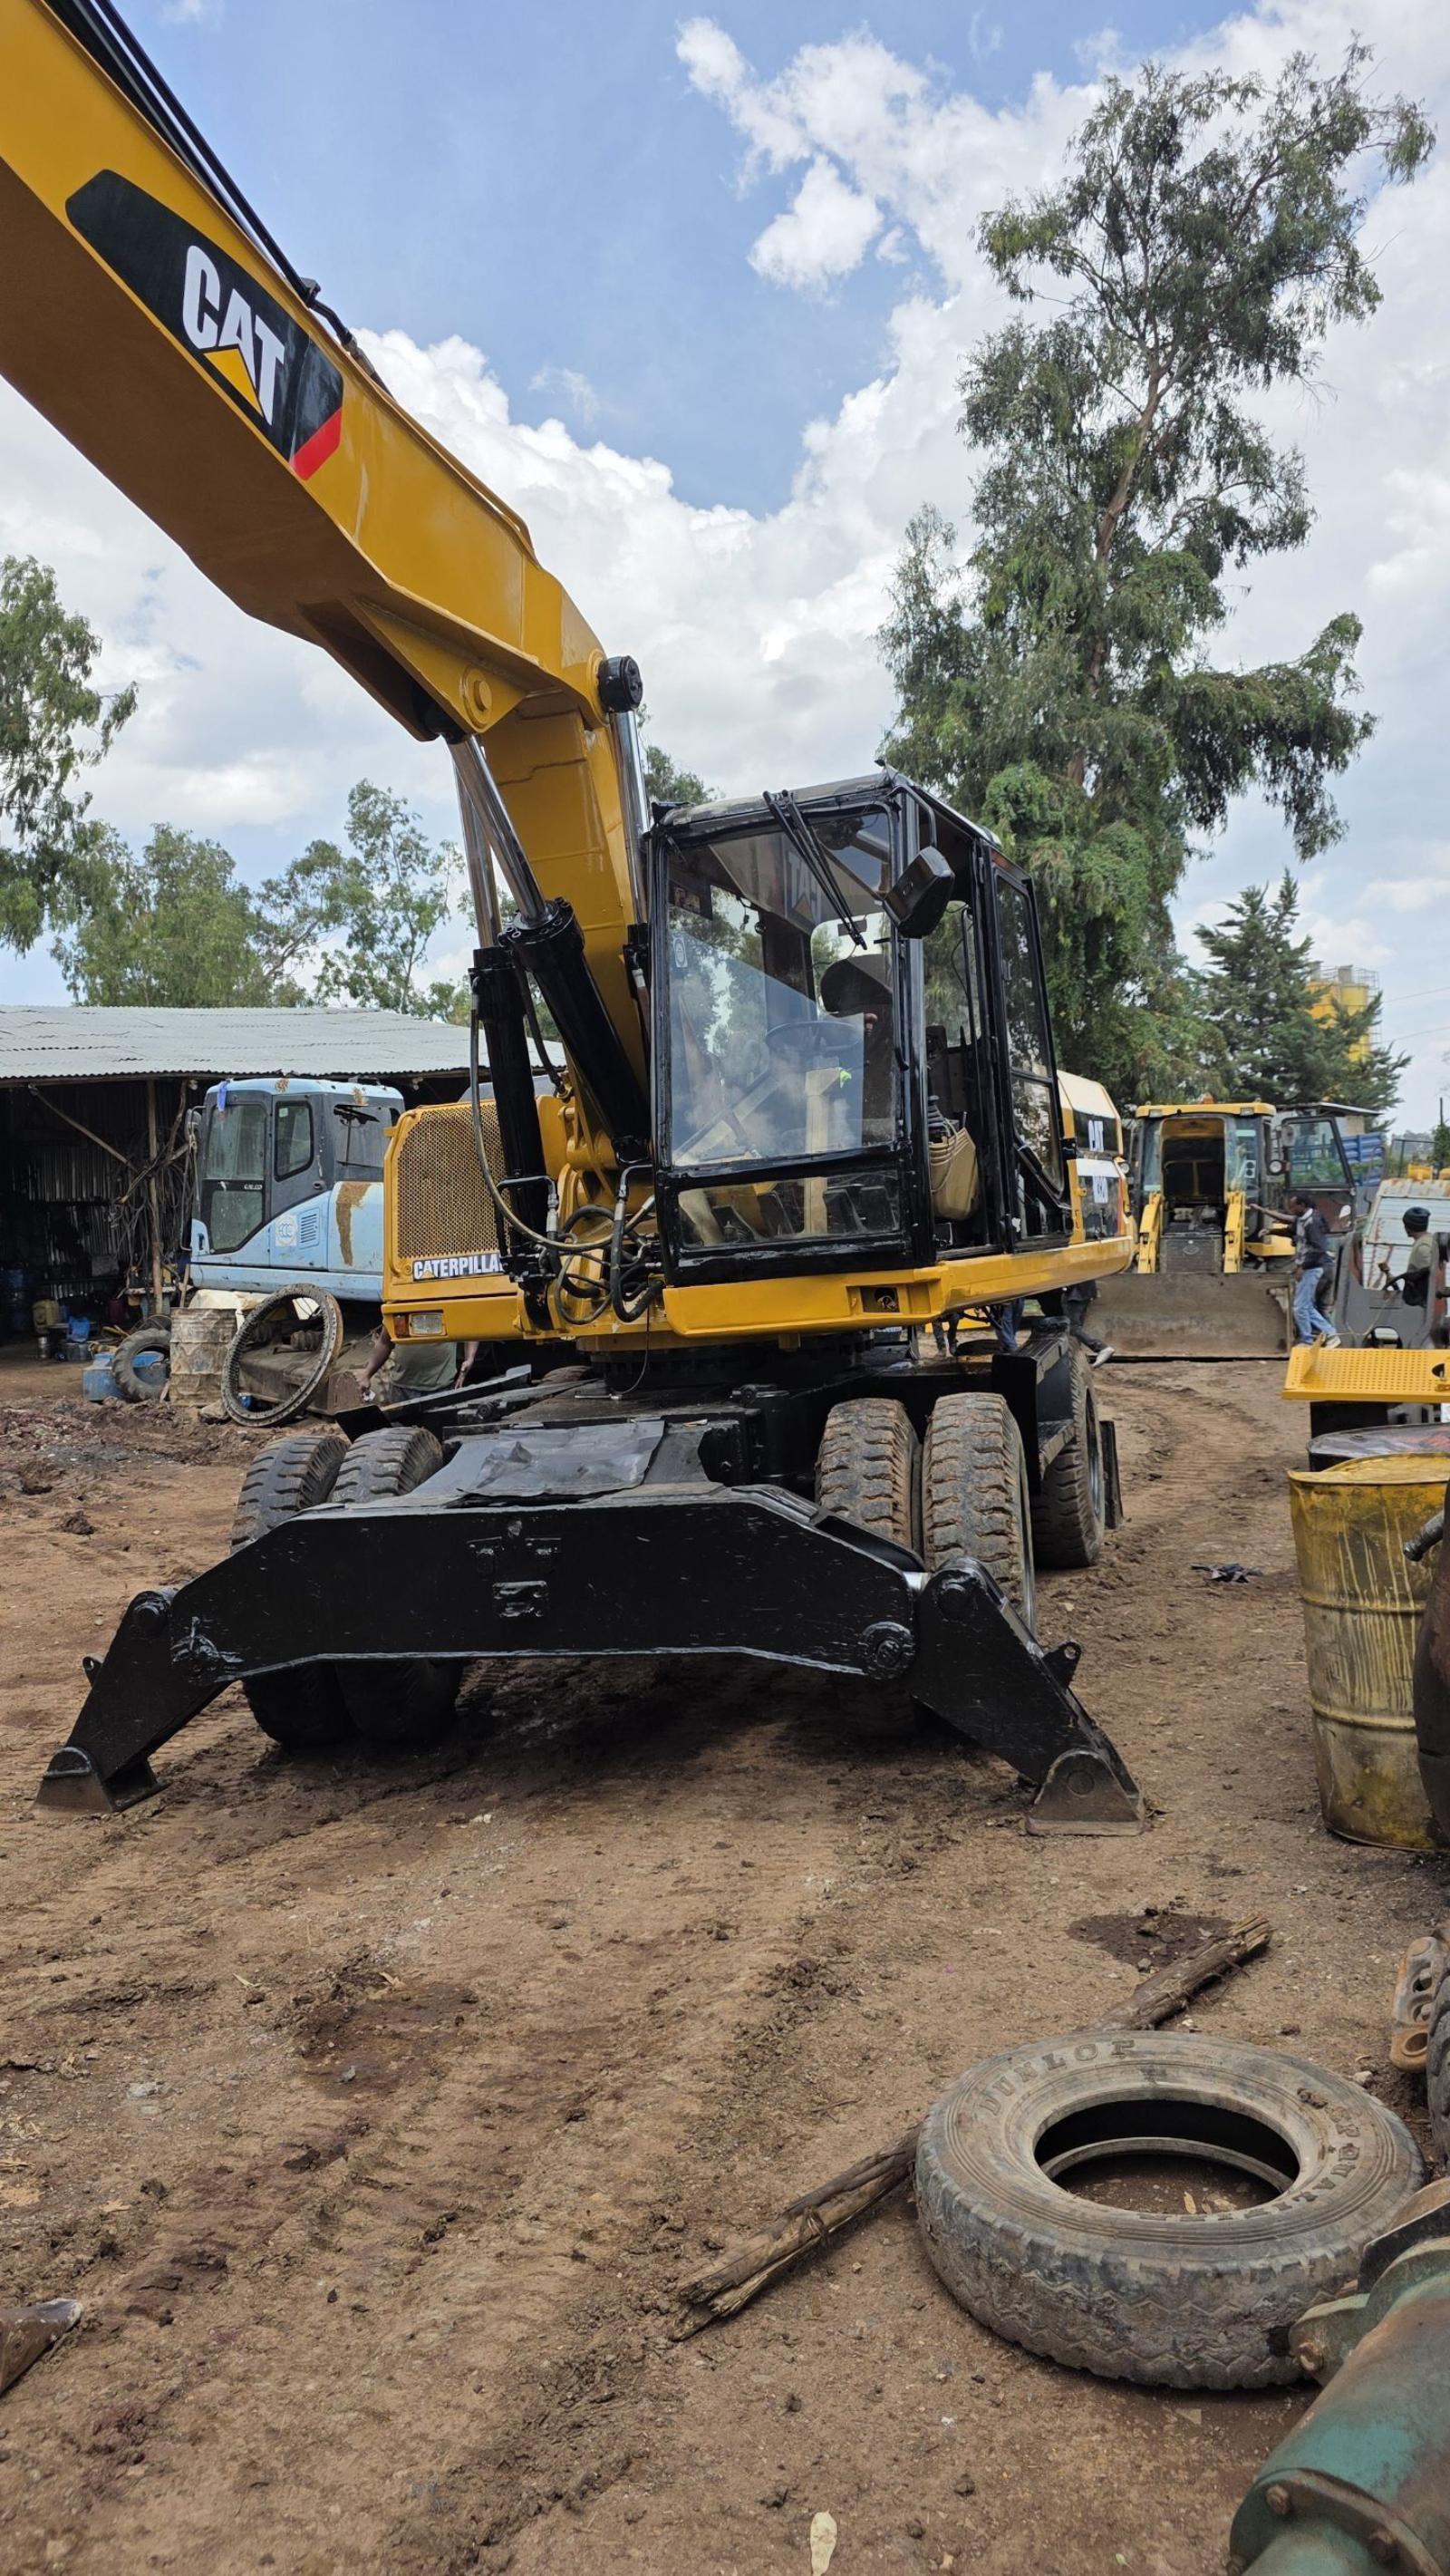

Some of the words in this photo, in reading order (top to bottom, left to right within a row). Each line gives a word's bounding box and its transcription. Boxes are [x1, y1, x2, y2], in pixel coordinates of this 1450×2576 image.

[182, 245, 285, 426] CAT
[413, 1253, 504, 1280] CATERPILLA
[979, 2039, 1135, 2116] DUNLOP
